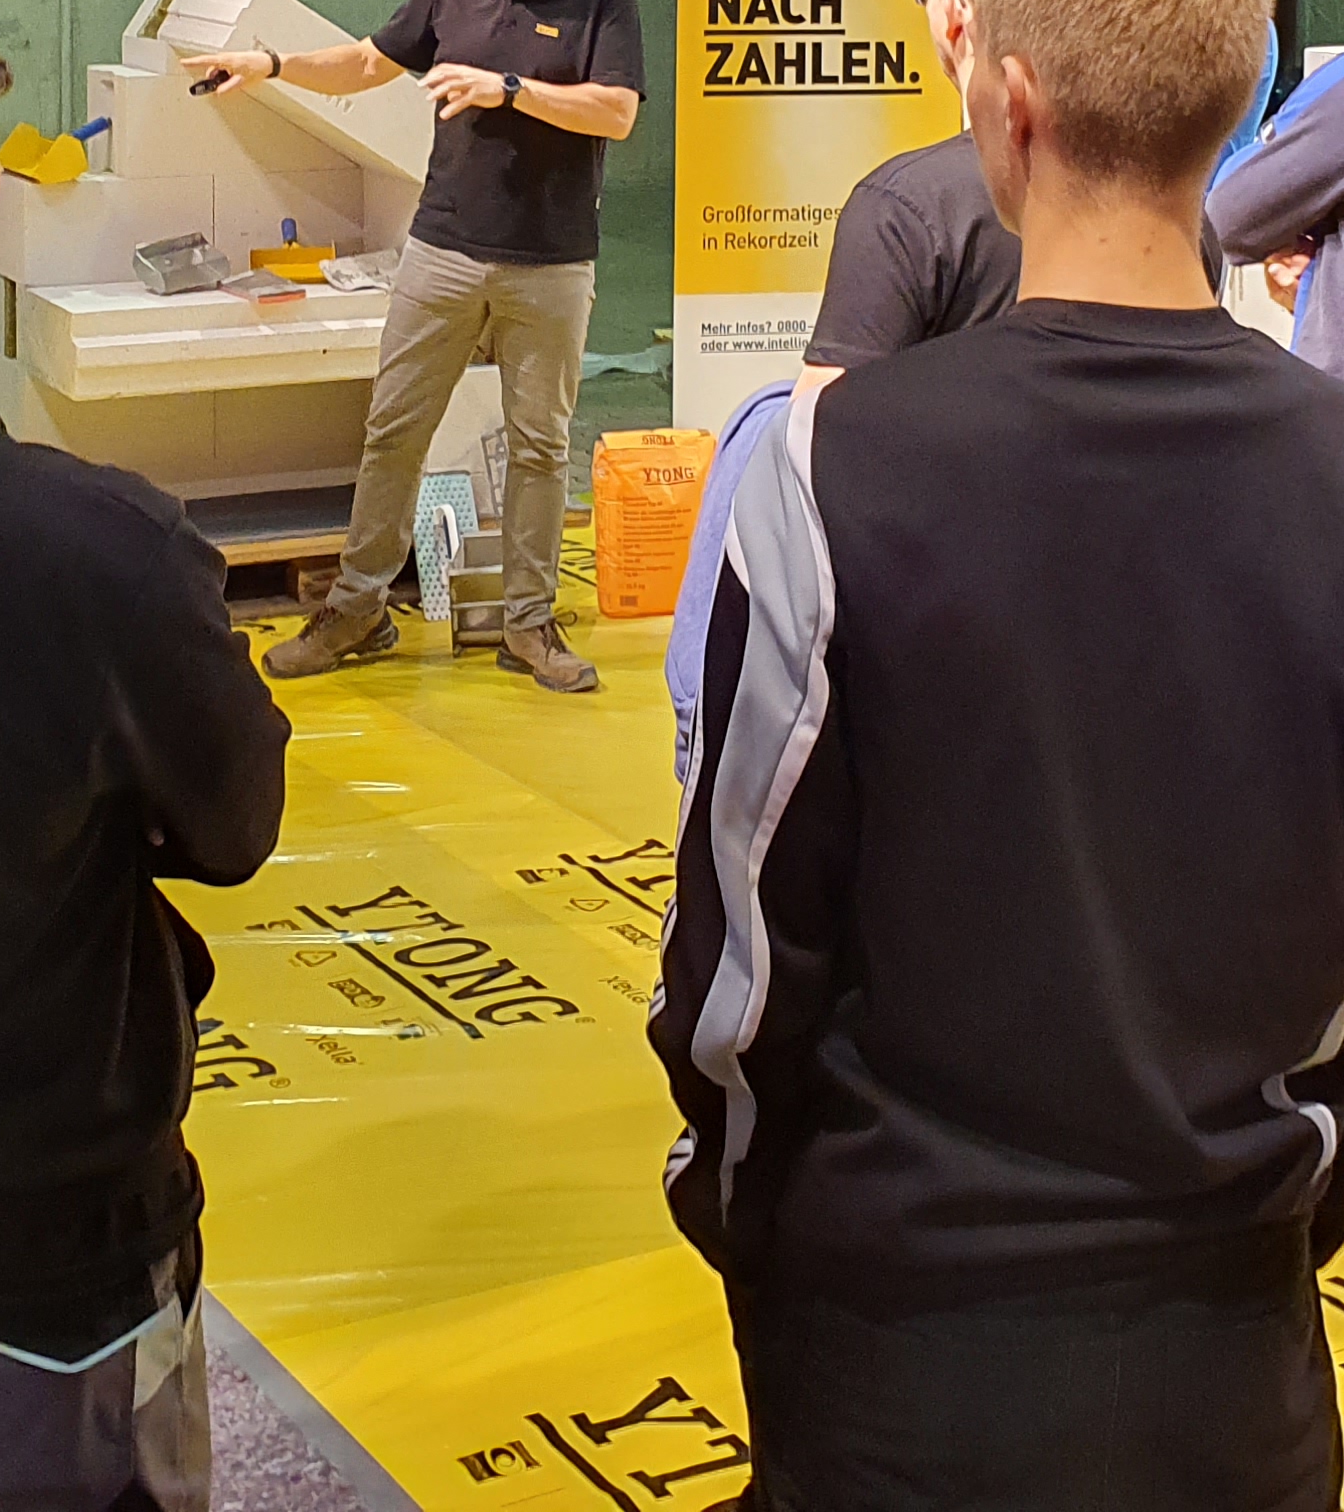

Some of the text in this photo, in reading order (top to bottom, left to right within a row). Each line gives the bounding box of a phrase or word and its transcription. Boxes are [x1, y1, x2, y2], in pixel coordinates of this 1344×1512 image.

[704, 41, 921, 85] ZAHLEN.
[702, 231, 819, 250] in Rekordzeit
[701, 323, 732, 334] Mehr
[736, 321, 772, 333] Infos?
[701, 340, 729, 351] oder
[643, 466, 695, 483] YTONG
[324, 886, 580, 1028] YTONG
